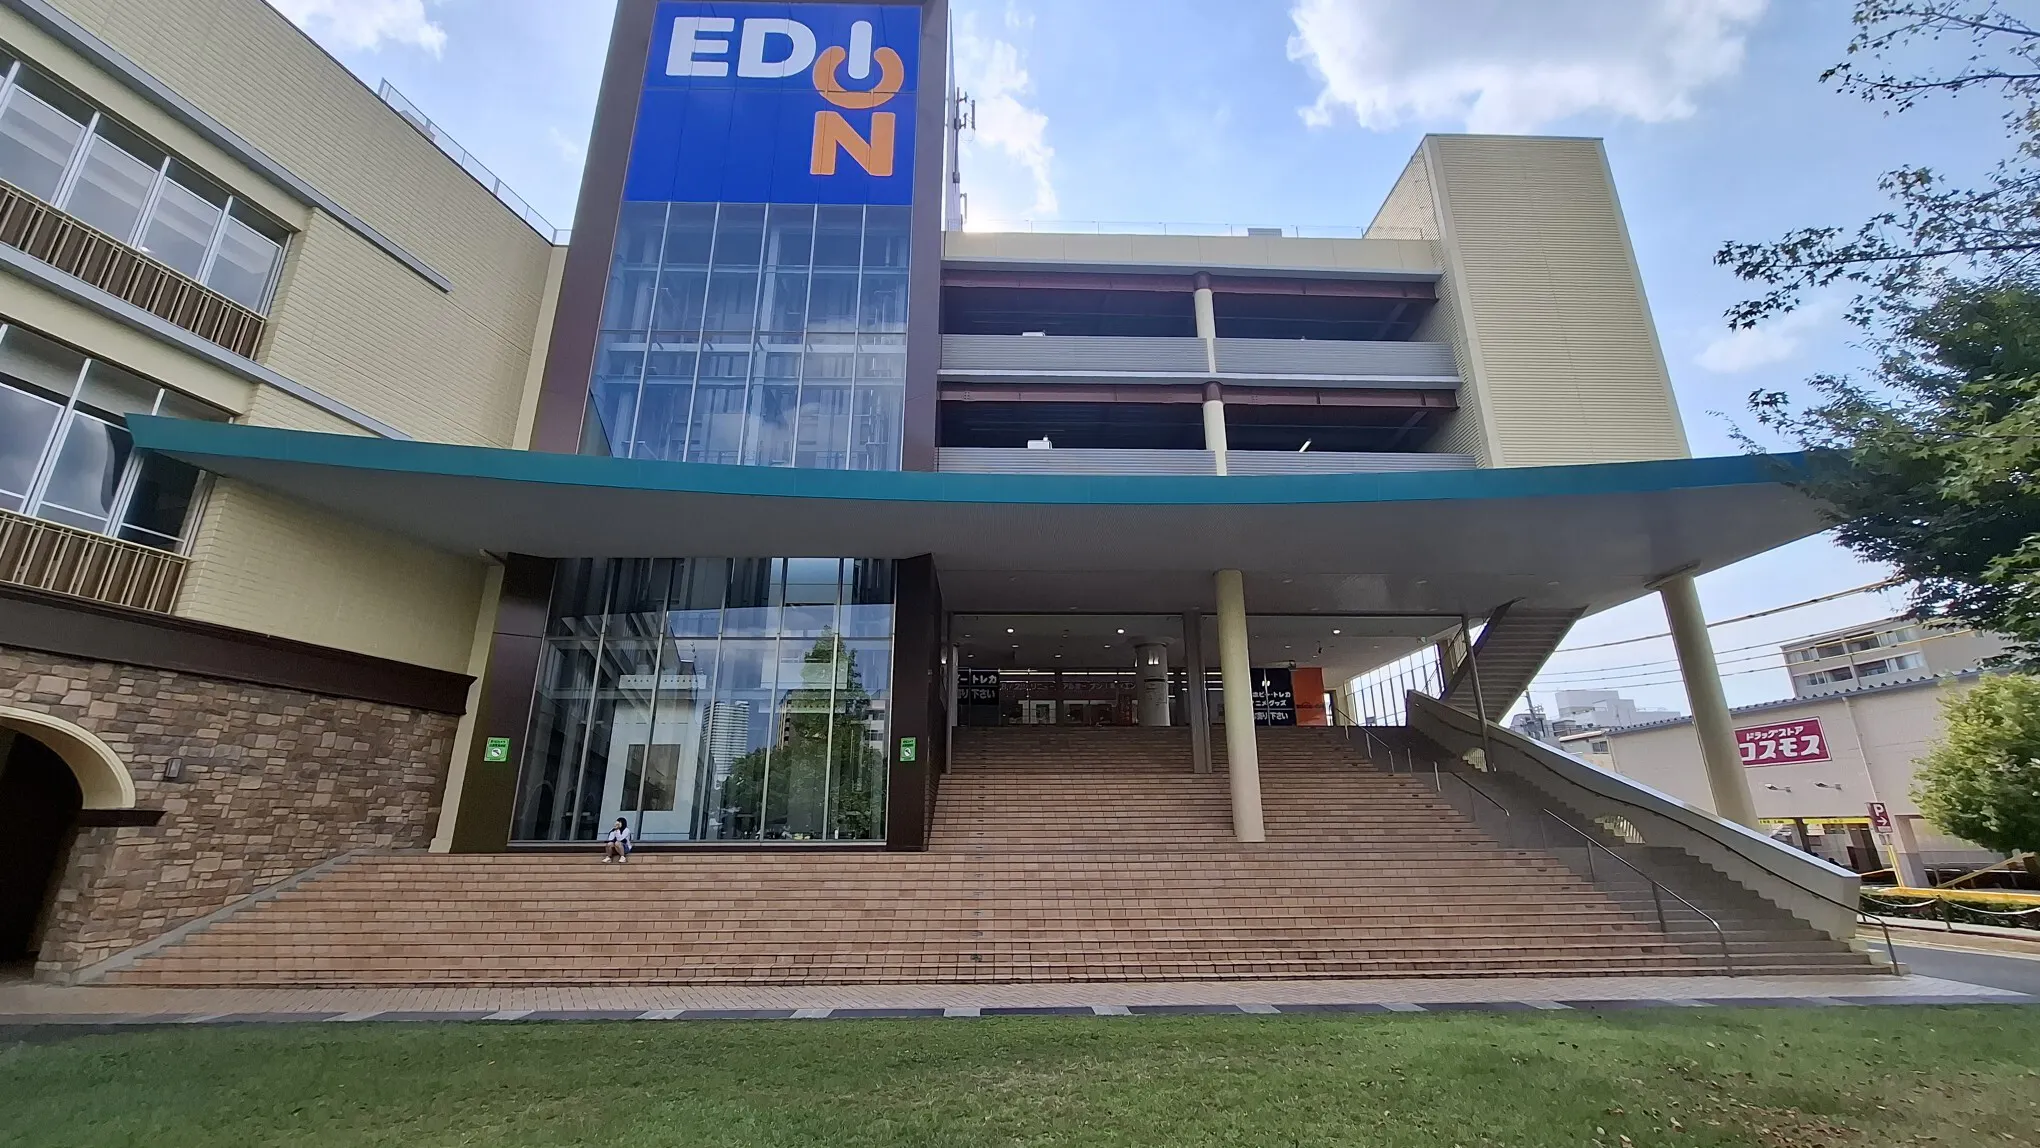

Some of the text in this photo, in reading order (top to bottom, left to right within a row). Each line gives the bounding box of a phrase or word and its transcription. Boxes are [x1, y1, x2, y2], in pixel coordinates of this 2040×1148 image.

[665, 16, 905, 177] EDION
[1253, 699, 1287, 707] ニメグッズ
[1746, 726, 1804, 741] ドラッグストア
[1739, 735, 1820, 761] コスモス
[1873, 804, 1885, 816] P
